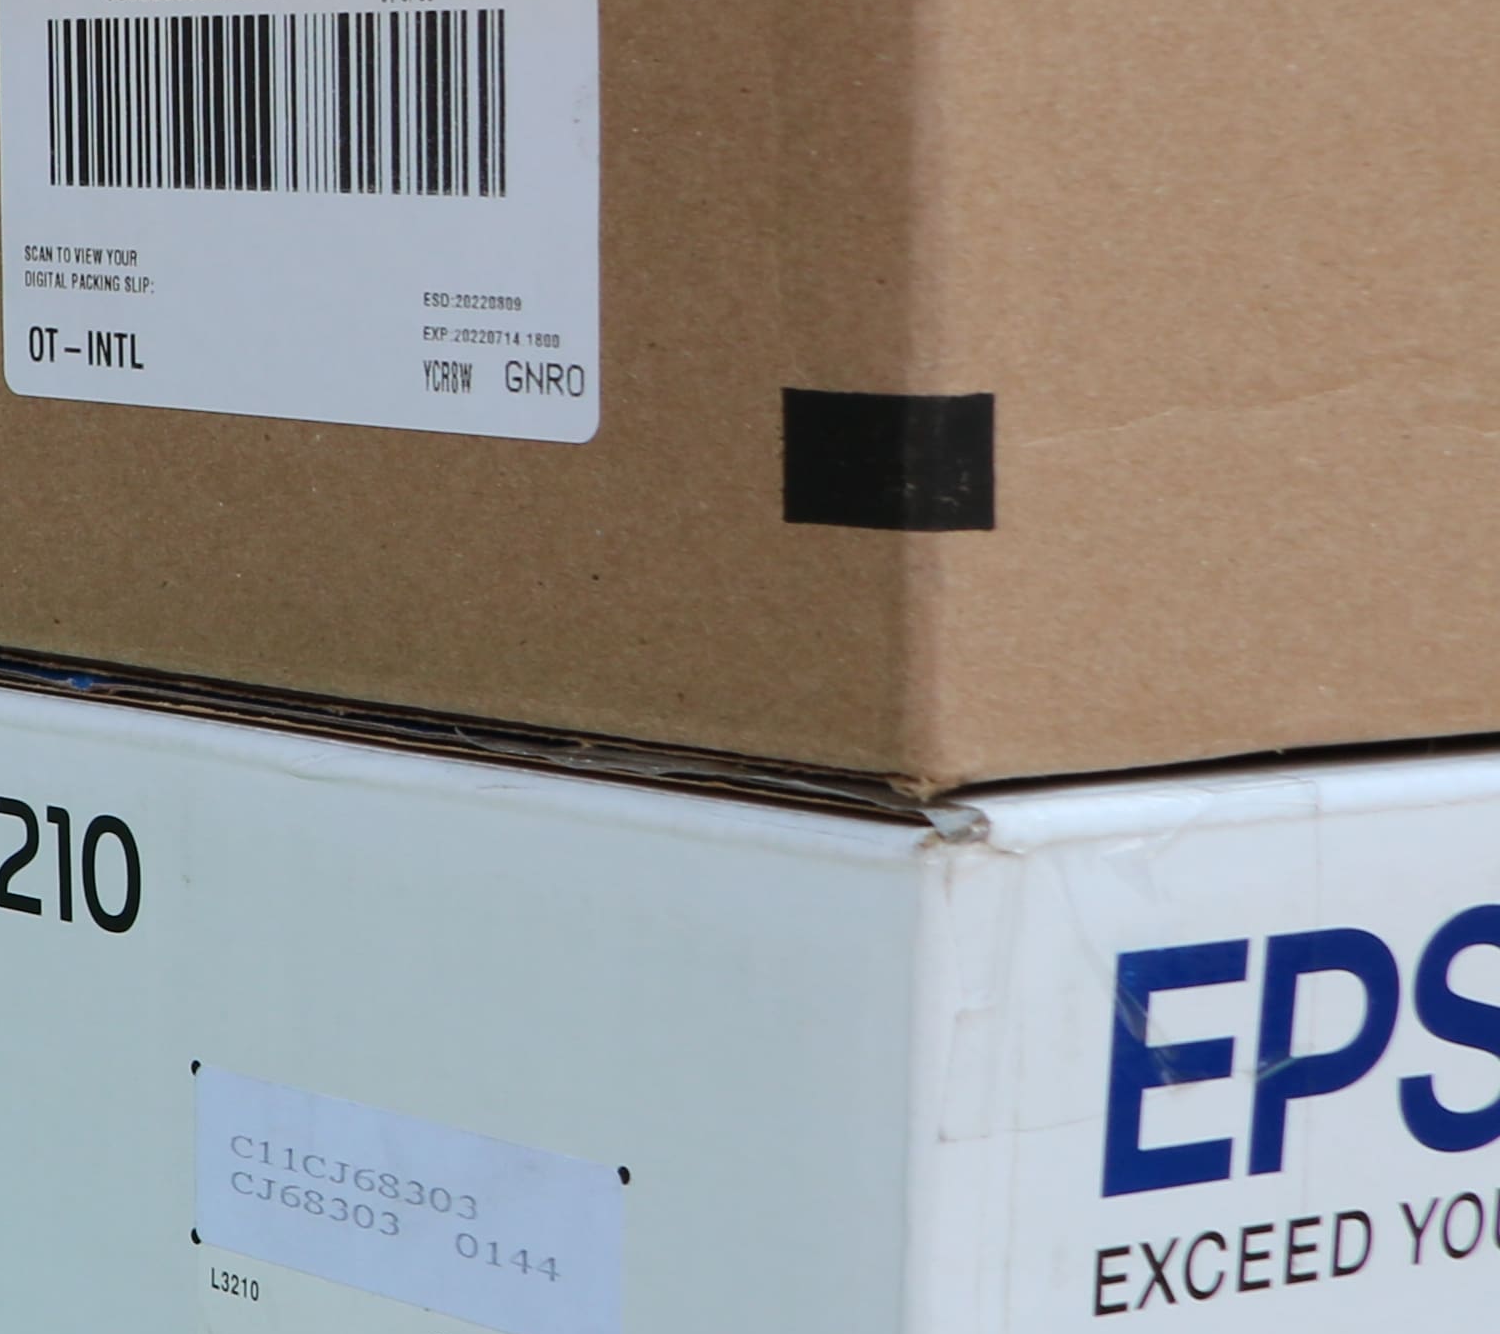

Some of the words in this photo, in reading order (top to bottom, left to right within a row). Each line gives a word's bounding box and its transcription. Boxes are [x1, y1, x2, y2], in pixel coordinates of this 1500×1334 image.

[24, 245, 53, 262] SCAN
[57, 247, 71, 263] TO
[74, 248, 103, 264] VIEW
[107, 249, 138, 267] YOUR
[25, 270, 67, 289] DIGITAL
[71, 273, 121, 291] PACKING
[229, 1134, 481, 1223] C11CJ68303
[229, 1171, 402, 1238] CJ68303
[454, 1230, 564, 1285] 0144
[210, 1266, 261, 1303] L3210
[1093, 1208, 1374, 1318] EXCEED
